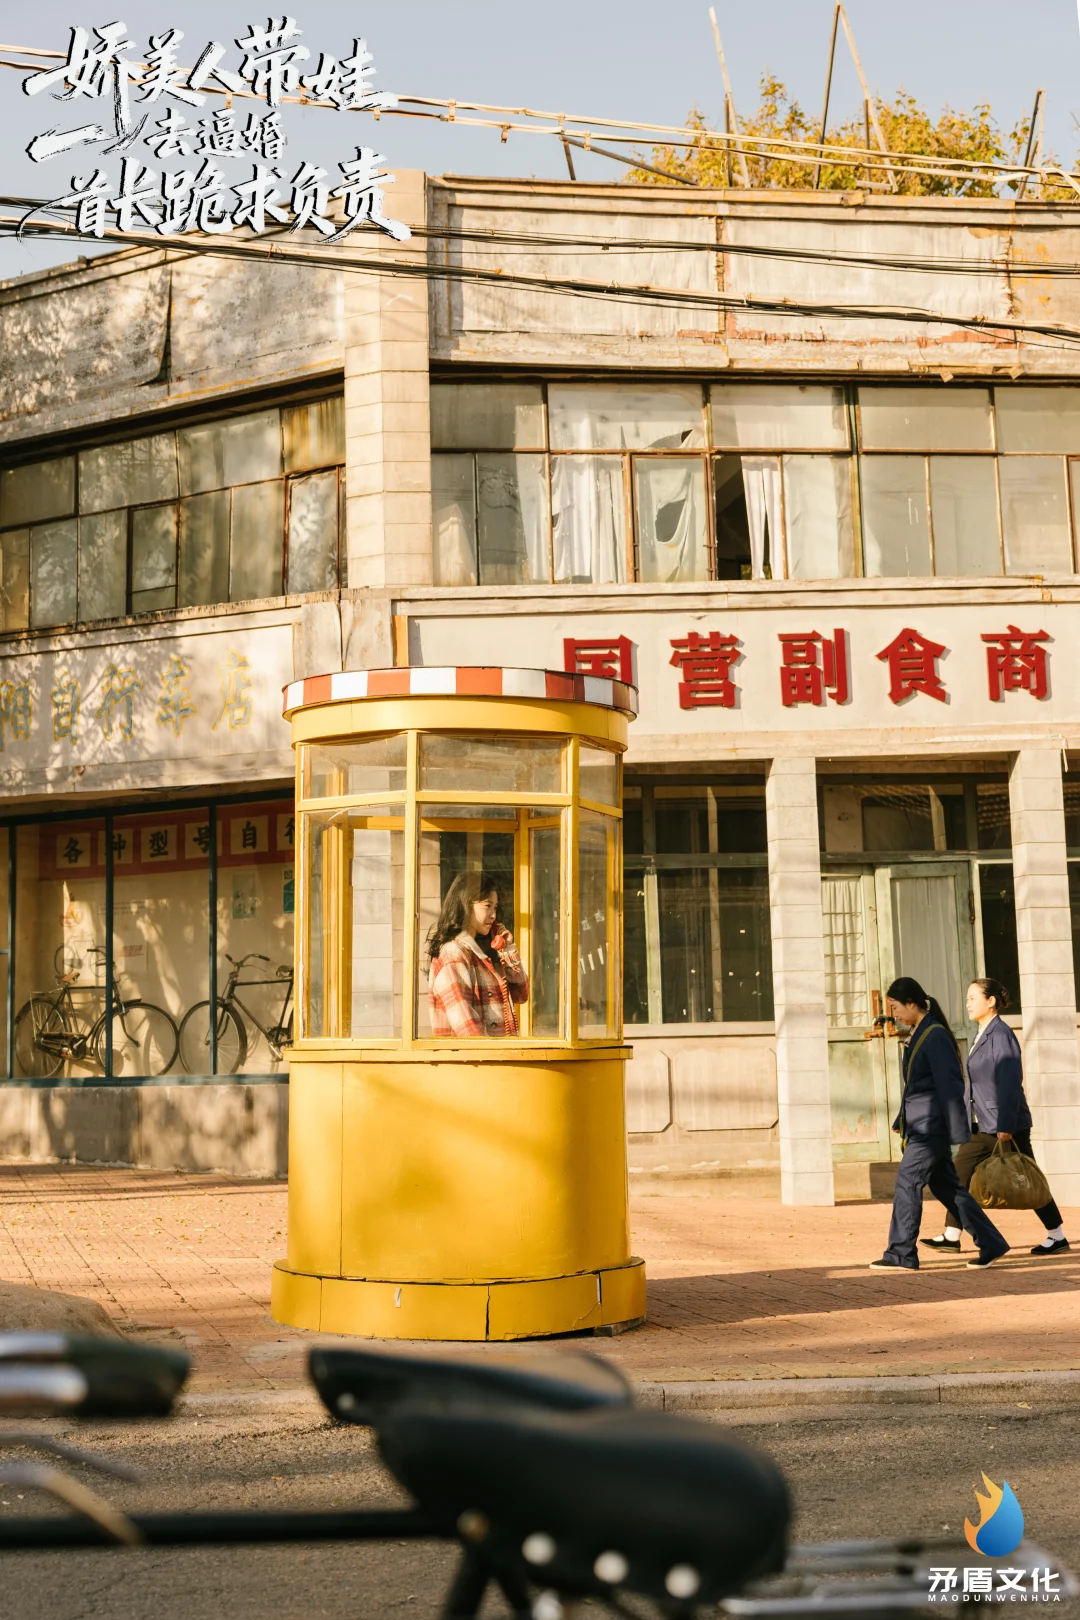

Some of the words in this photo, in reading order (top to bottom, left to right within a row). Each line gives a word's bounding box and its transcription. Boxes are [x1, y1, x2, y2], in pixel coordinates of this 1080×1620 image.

[563, 625, 1050, 709] 国营副食商
